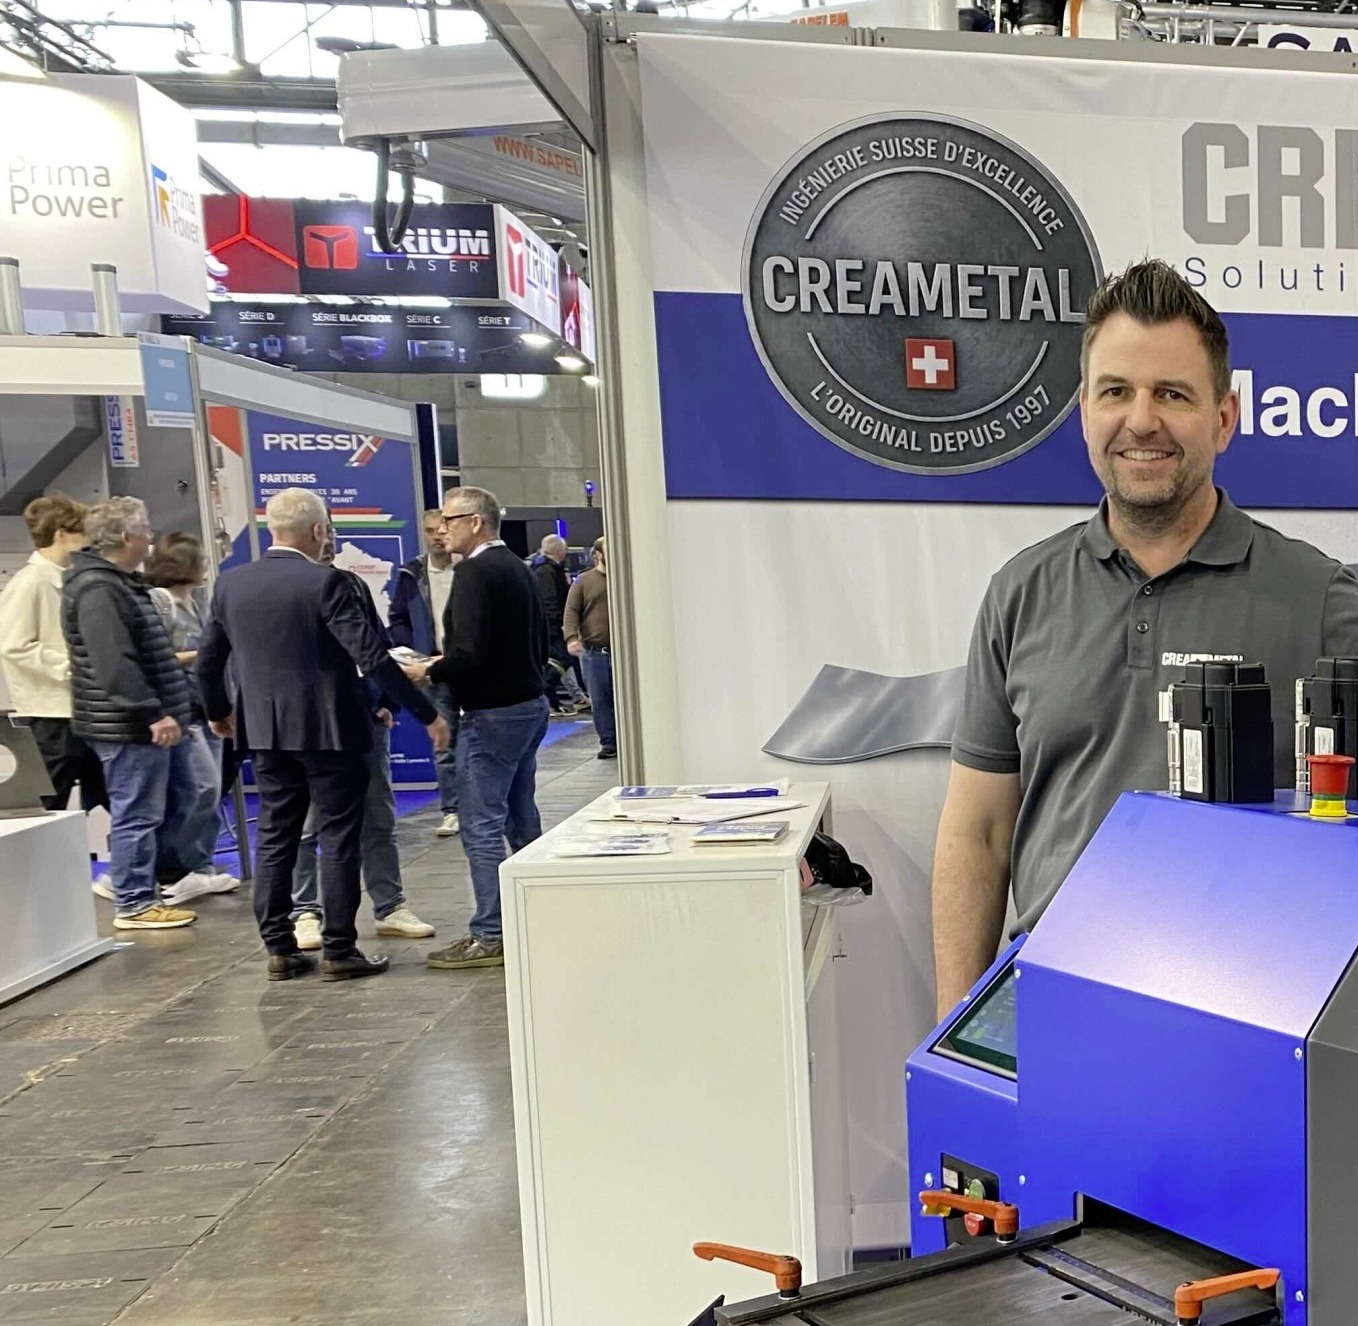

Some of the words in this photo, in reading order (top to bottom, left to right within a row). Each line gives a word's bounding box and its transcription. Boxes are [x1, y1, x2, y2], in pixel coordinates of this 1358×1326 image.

[8, 154, 111, 188] Prima
[10, 184, 124, 219] Power
[169, 176, 197, 215] Prima
[779, 146, 868, 225] INGÉNIERIE
[869, 137, 938, 162] SUISSE
[944, 141, 1065, 236] D'EXCELLENCE
[172, 206, 200, 244] Power
[386, 258, 479, 272] LASER
[762, 255, 1087, 323] CREAMETAL
[239, 310, 264, 321] SÉRIE
[312, 312, 338, 322] SÉRIE
[340, 314, 393, 323] BLACKBOX
[406, 314, 432, 325] SÉRIE
[433, 316, 441, 324] C
[478, 315, 503, 326] SÉRIE
[504, 317, 511, 325] T
[810, 381, 922, 452] L'ORIGINAL
[930, 422, 1005, 453] DEPUIS
[1006, 384, 1051, 430] 1997
[263, 433, 378, 463] PRESSIX
[260, 473, 317, 484] PARTNERS
[1161, 652, 1190, 666] CREA
